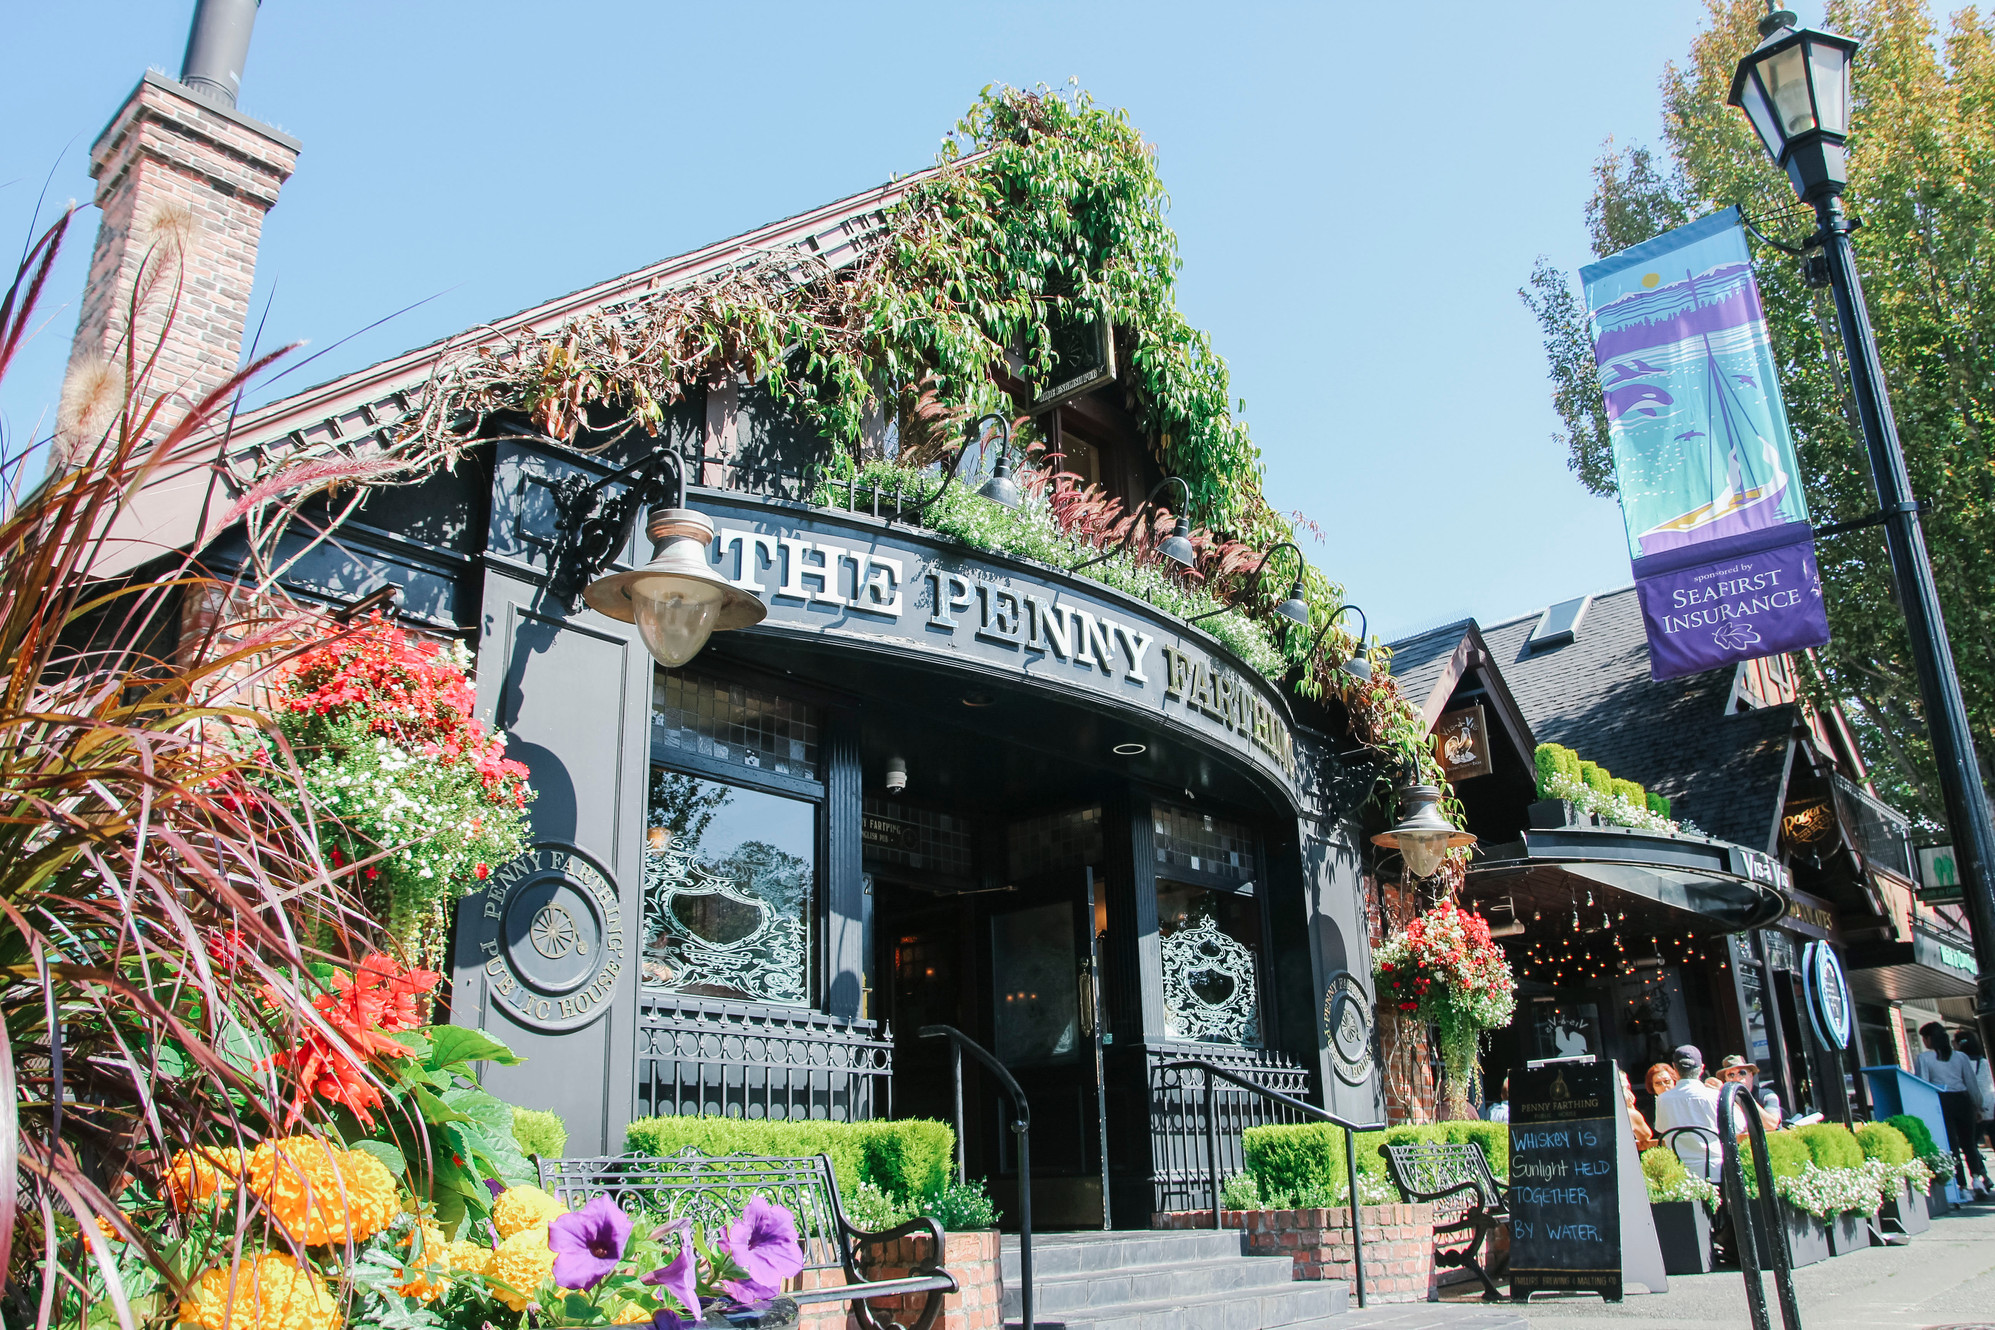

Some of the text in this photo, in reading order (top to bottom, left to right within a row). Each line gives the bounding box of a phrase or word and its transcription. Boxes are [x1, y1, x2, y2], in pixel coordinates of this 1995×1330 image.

[1694, 562, 1753, 583] sponsored by
[1672, 569, 1782, 609] SEAFIRST
[719, 528, 903, 617] THE
[926, 568, 1154, 684] PENNY
[1662, 589, 1801, 634] INSURANCE
[484, 850, 623, 953] PENNY FARTHING
[480, 938, 623, 1020] PUBLIC HOUSE
[1521, 1099, 1599, 1113] PENNY FARTHING
[1512, 1155, 1611, 1182] Sunlight HELD
[1512, 1186, 1589, 1207] TOGETHER
[1514, 1220, 1603, 1242] BY WATER.
[1542, 1276, 1570, 1286] BREWING
[1577, 1276, 1607, 1286] MALTING
